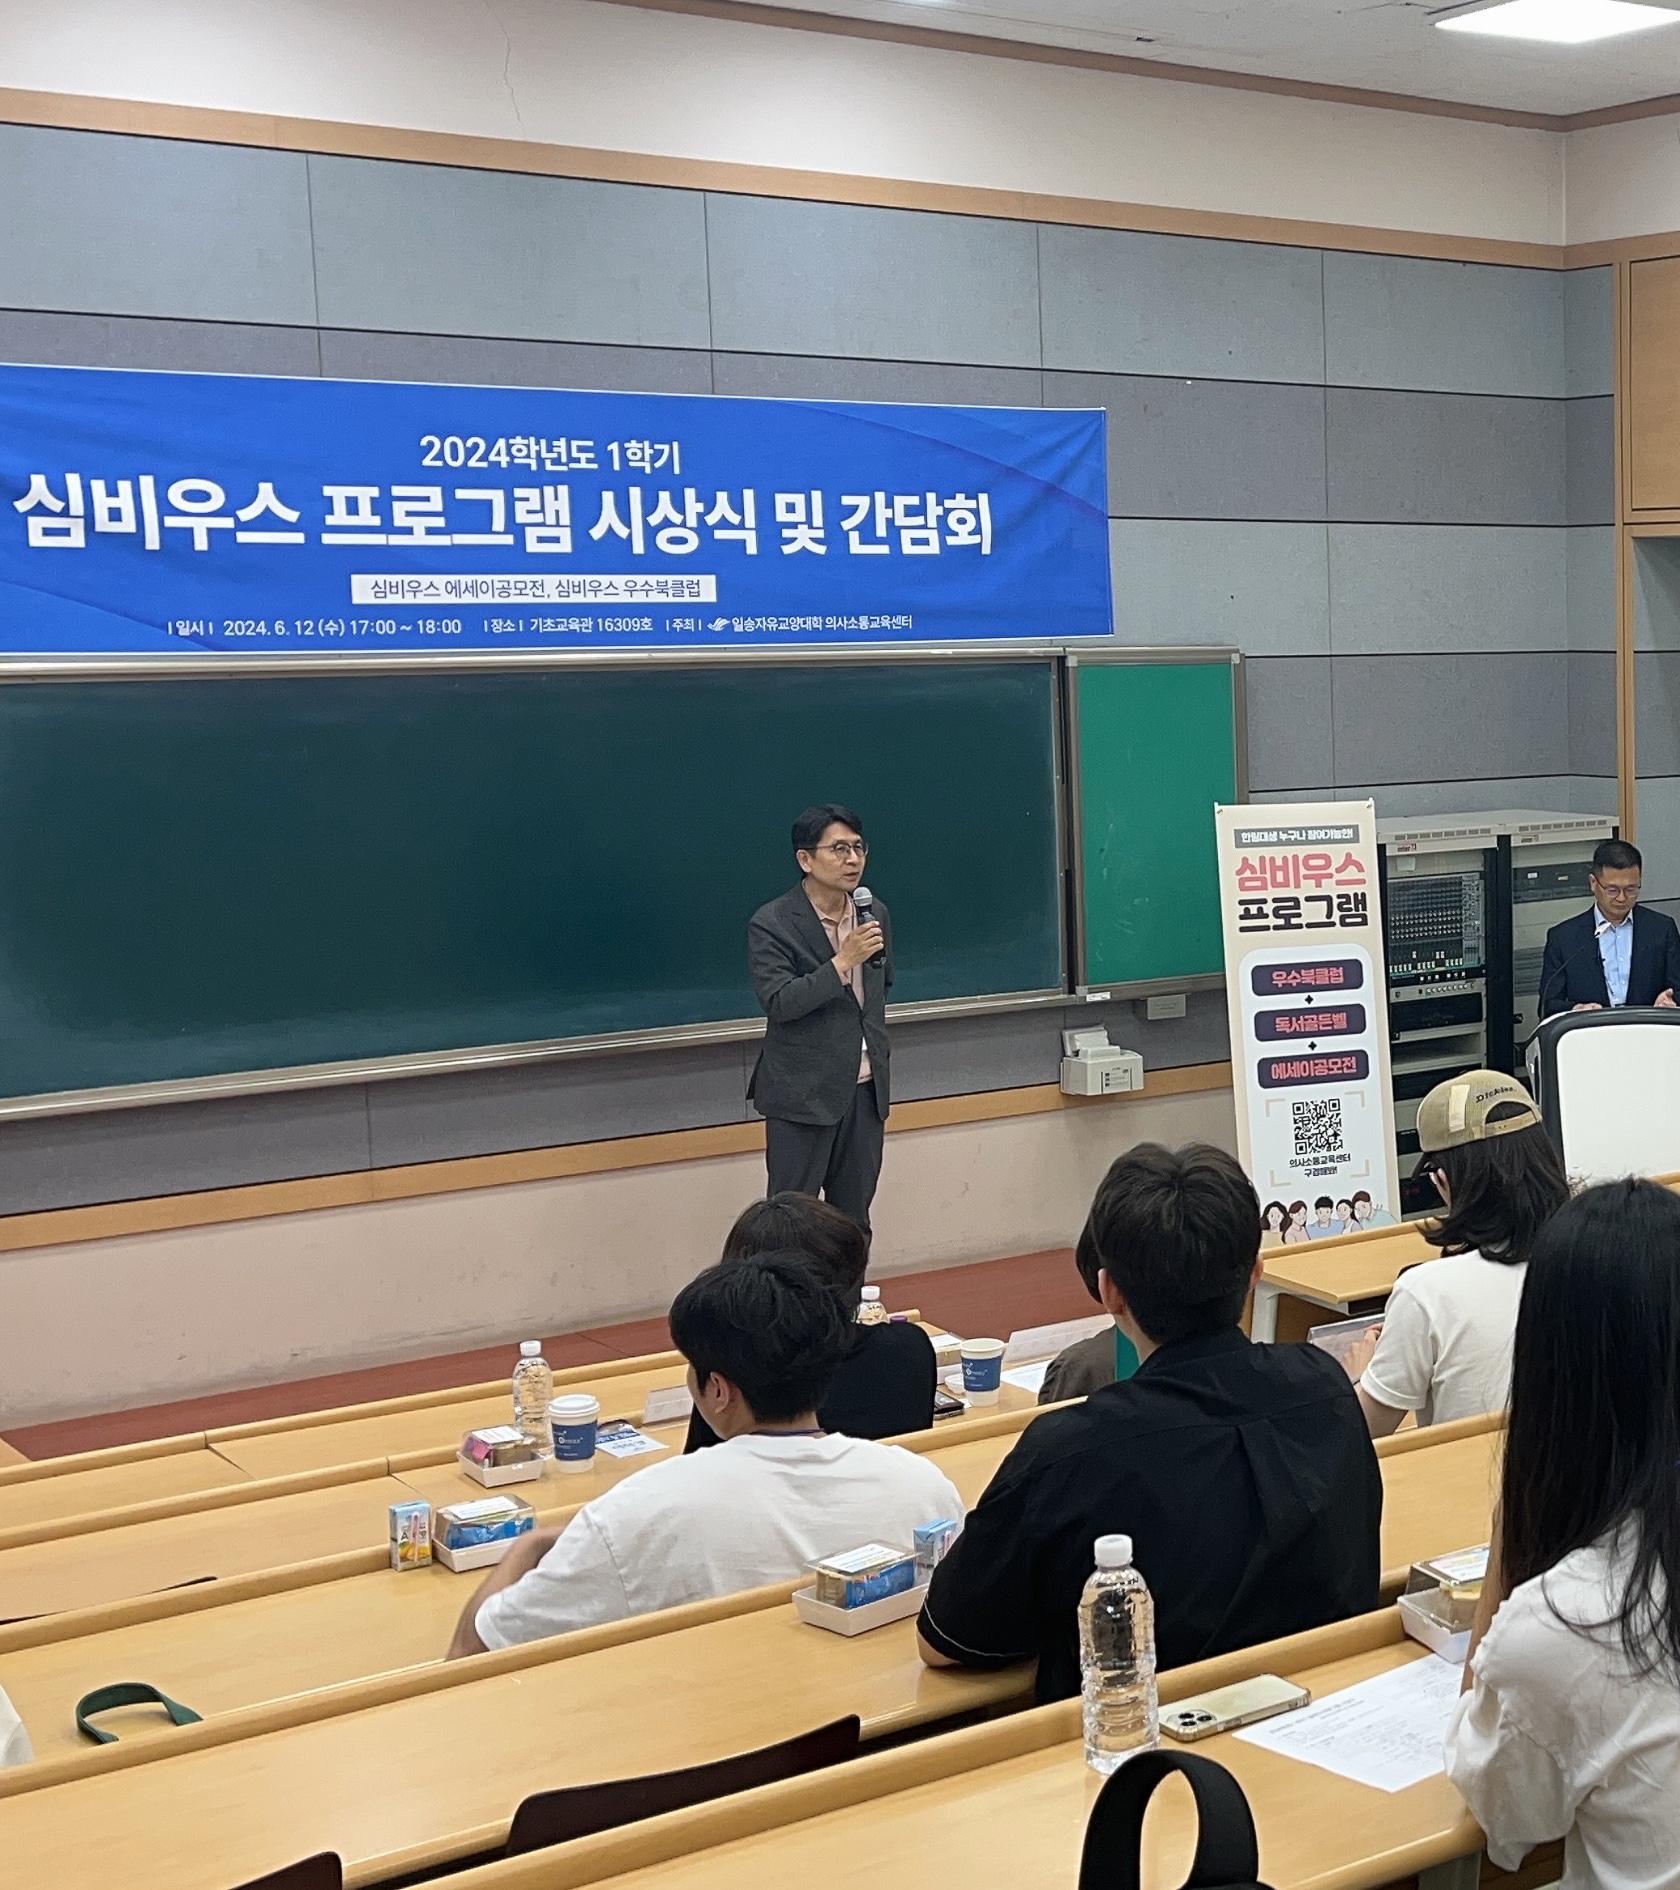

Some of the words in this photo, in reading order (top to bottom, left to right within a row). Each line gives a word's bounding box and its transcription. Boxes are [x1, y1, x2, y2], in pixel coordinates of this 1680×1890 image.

[420, 435, 598, 472] 2024학년도
[607, 440, 681, 475] 1학기
[13, 472, 305, 551] 심비우스
[321, 484, 573, 554] 프로그램
[589, 486, 757, 556] 시상식
[774, 490, 828, 556] 및
[840, 491, 992, 556] 간담회
[370, 579, 440, 599] 심비우스
[444, 579, 551, 600] 에세이공모전,
[555, 579, 620, 599] 심비우스
[623, 579, 701, 598] 우수북클럽
[223, 620, 271, 636] 2024.
[274, 620, 291, 636] 6.
[294, 620, 315, 636] 12
[318, 618, 345, 637] (수)
[350, 619, 396, 635] 17:00
[417, 619, 462, 634] 18:00
[530, 617, 594, 633] 기초교육관
[597, 616, 653, 632] 16309호
[731, 615, 823, 632] 일송자유교양대학
[825, 614, 913, 631] 의사소통교육센터
[1279, 828, 1306, 841] 누구나
[1235, 852, 1366, 892] 심비우스
[1238, 892, 1369, 933] 프로그램
[1272, 966, 1344, 988] 우수북클럽
[1275, 1012, 1347, 1034] 독서골든벨
[1271, 1056, 1357, 1080] 에세이공모전
[1289, 1153, 1351, 1169] 의사소통교육센터
